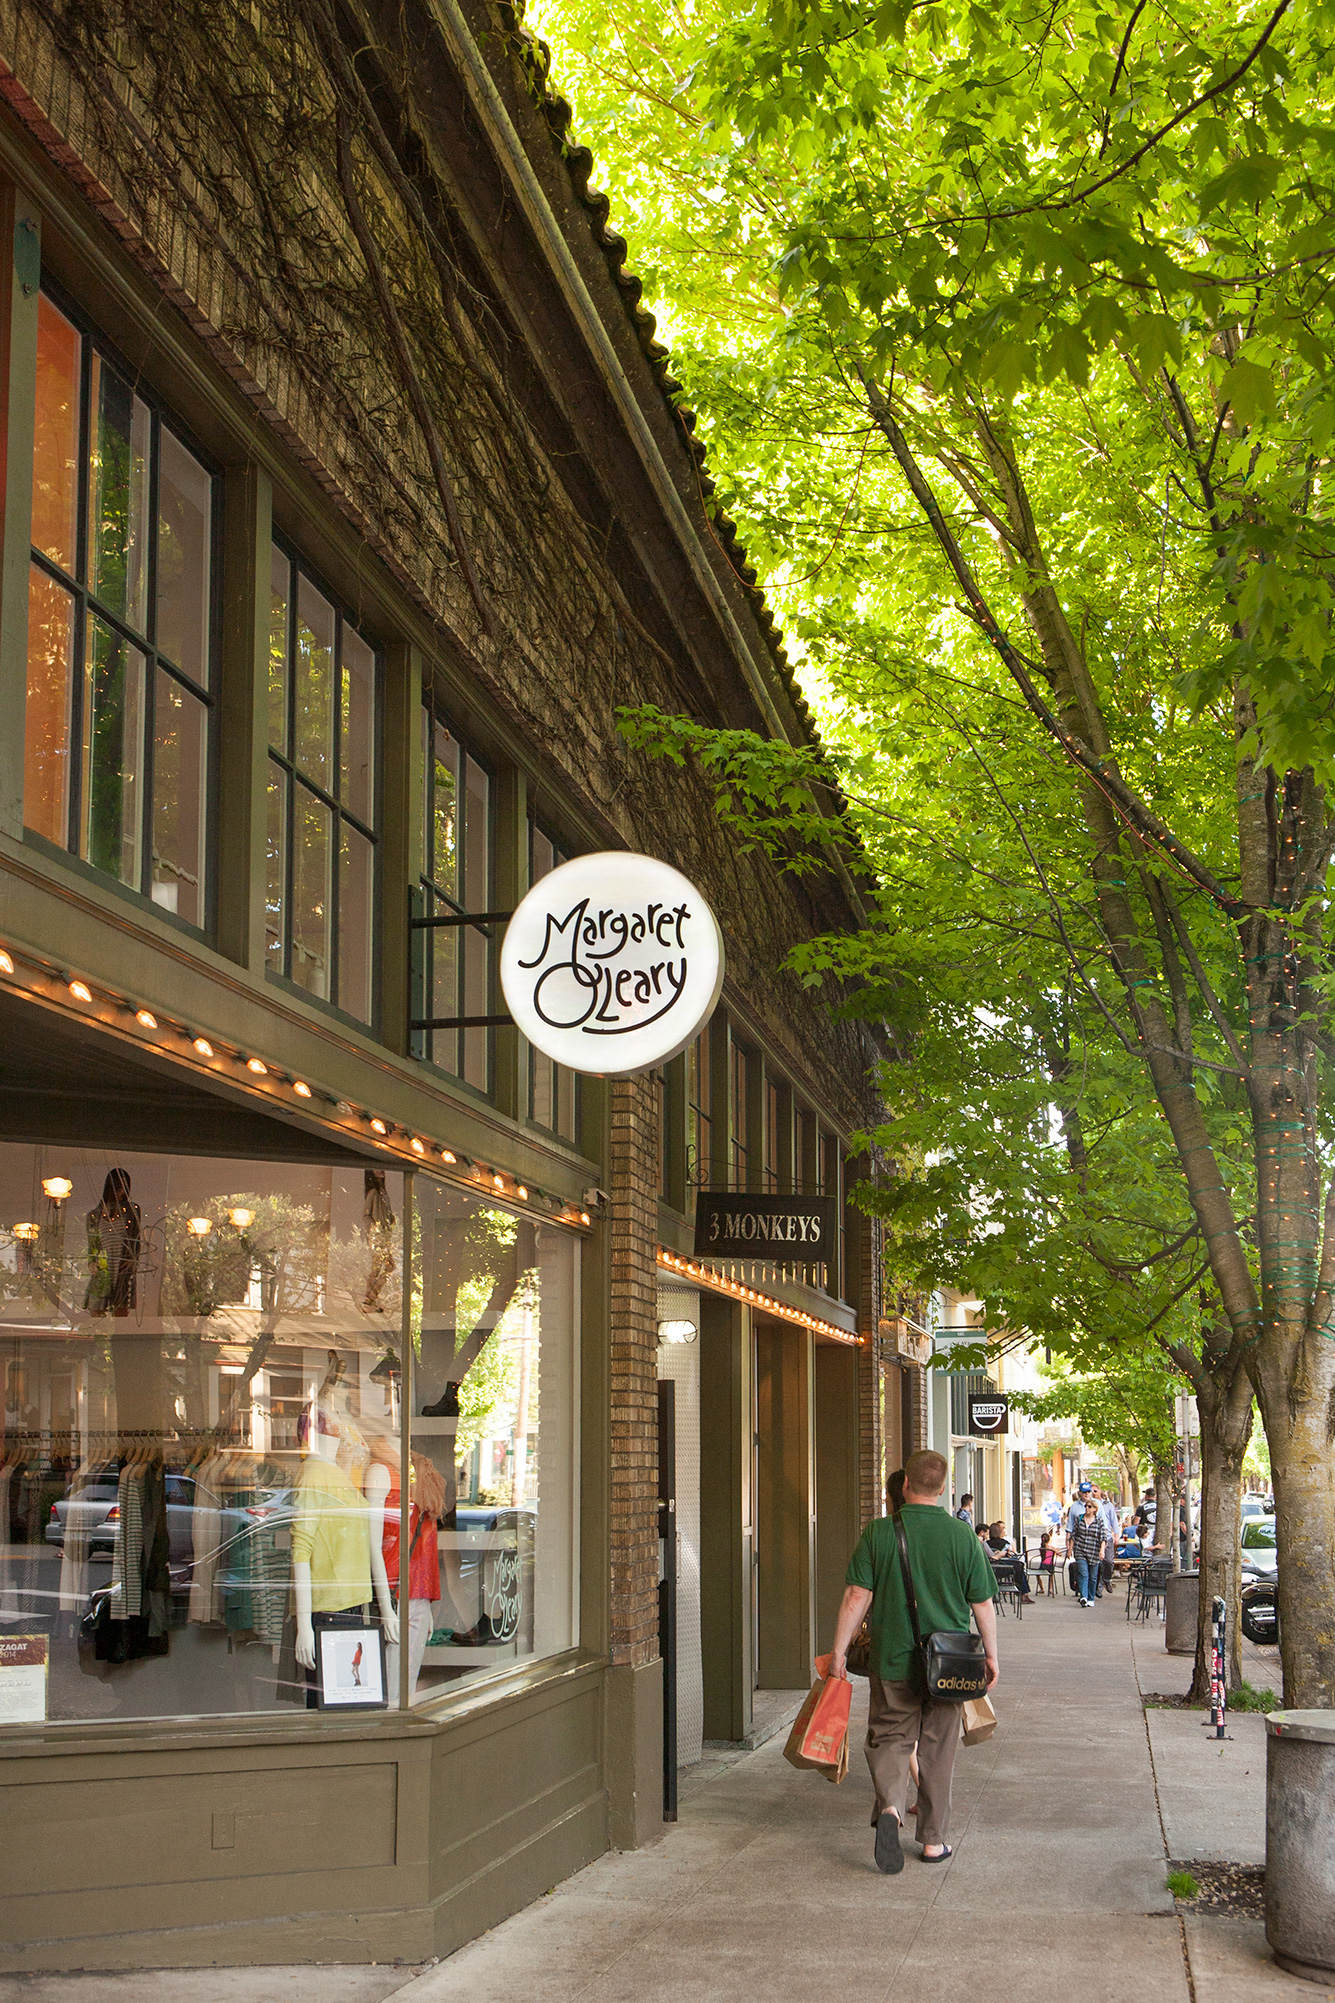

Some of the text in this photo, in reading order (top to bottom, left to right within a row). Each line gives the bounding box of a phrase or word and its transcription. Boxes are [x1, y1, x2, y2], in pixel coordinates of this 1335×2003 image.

[517, 897, 692, 972] Margaret
[709, 1212, 821, 1243] 3 MONKEYS
[972, 1406, 1002, 1415] BARISTA
[487, 1549, 523, 1598] Margaret
[0, 1643, 28, 1651] ZAGAT
[0, 1651, 17, 1659] 2014
[937, 1676, 977, 1691] adidas
